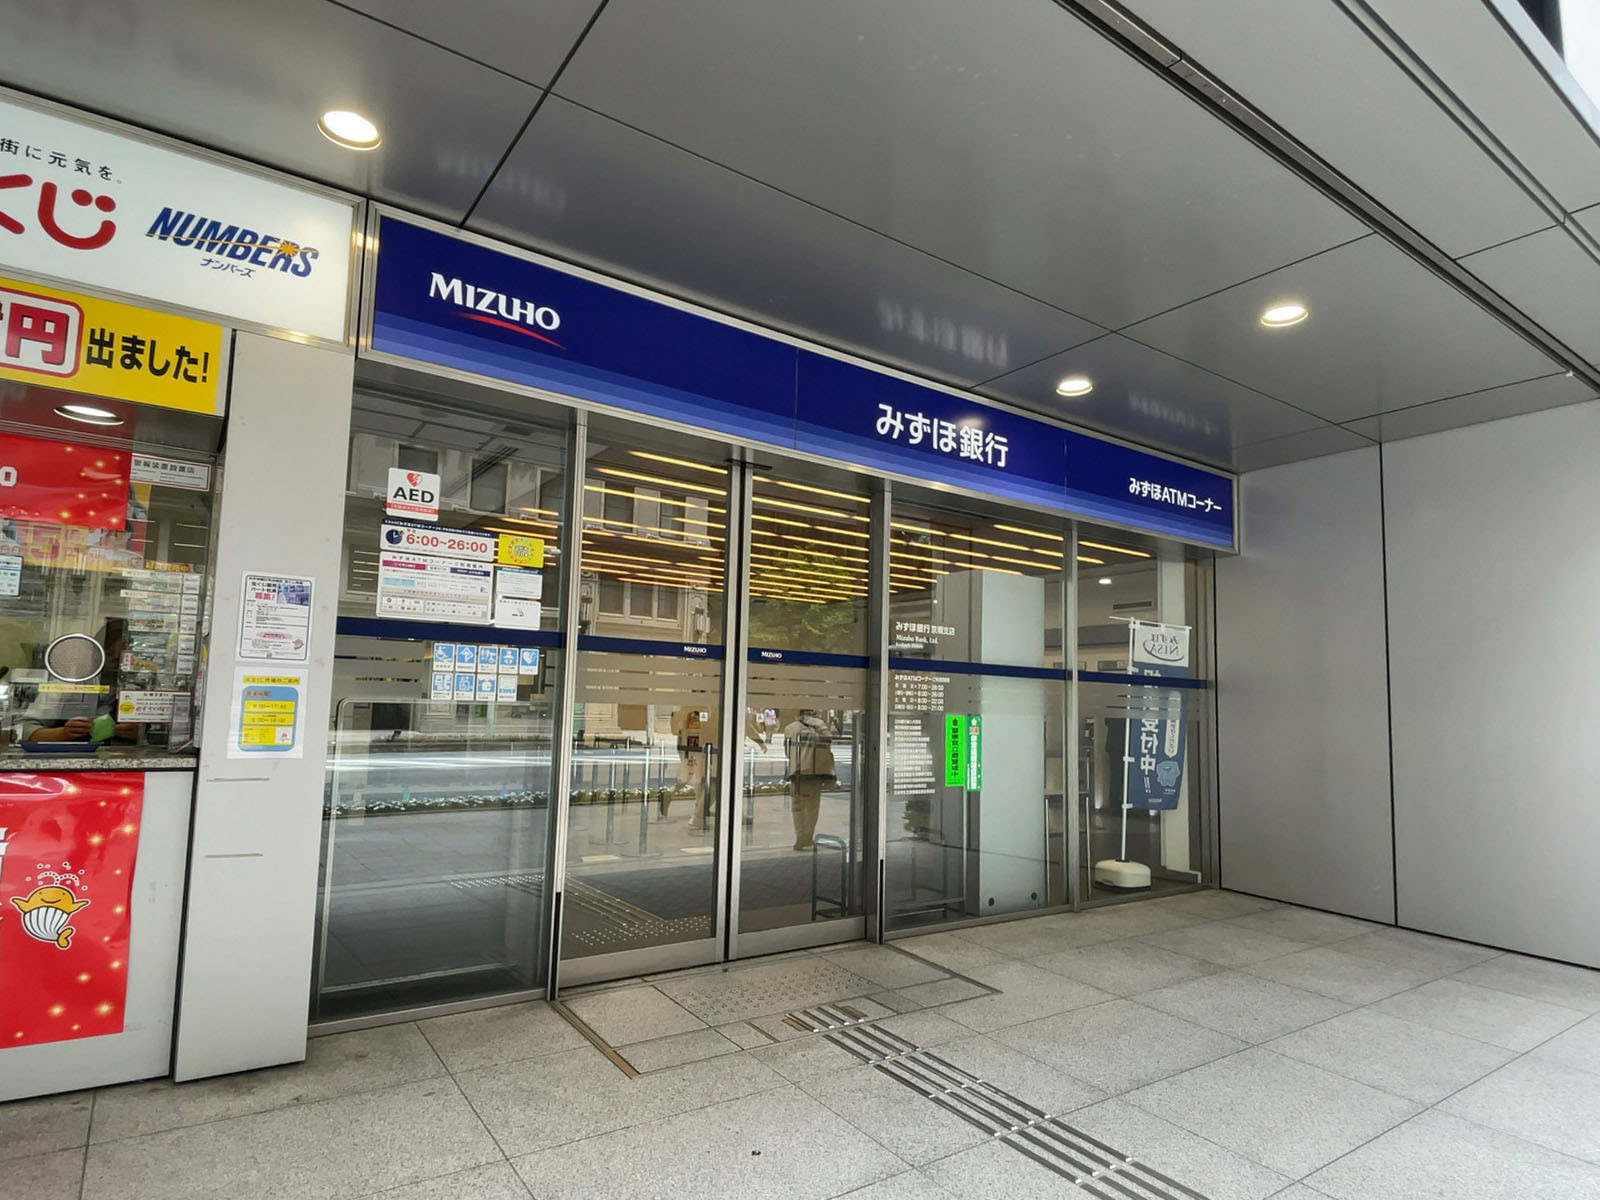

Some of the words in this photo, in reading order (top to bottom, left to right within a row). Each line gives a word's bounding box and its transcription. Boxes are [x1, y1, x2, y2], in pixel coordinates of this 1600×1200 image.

[145, 207, 319, 278] NUMBERS
[200, 257, 256, 278] ナンバーズ
[429, 272, 561, 331] MIZUHO
[0, 302, 70, 366] 円
[86, 327, 209, 384] 出ました!
[876, 403, 1009, 468] みずほ銀行
[393, 486, 434, 504] AED
[1129, 477, 1222, 513] みずほATMコーナー
[683, 646, 707, 654] MIZUHO
[761, 651, 783, 659] MIZUHO
